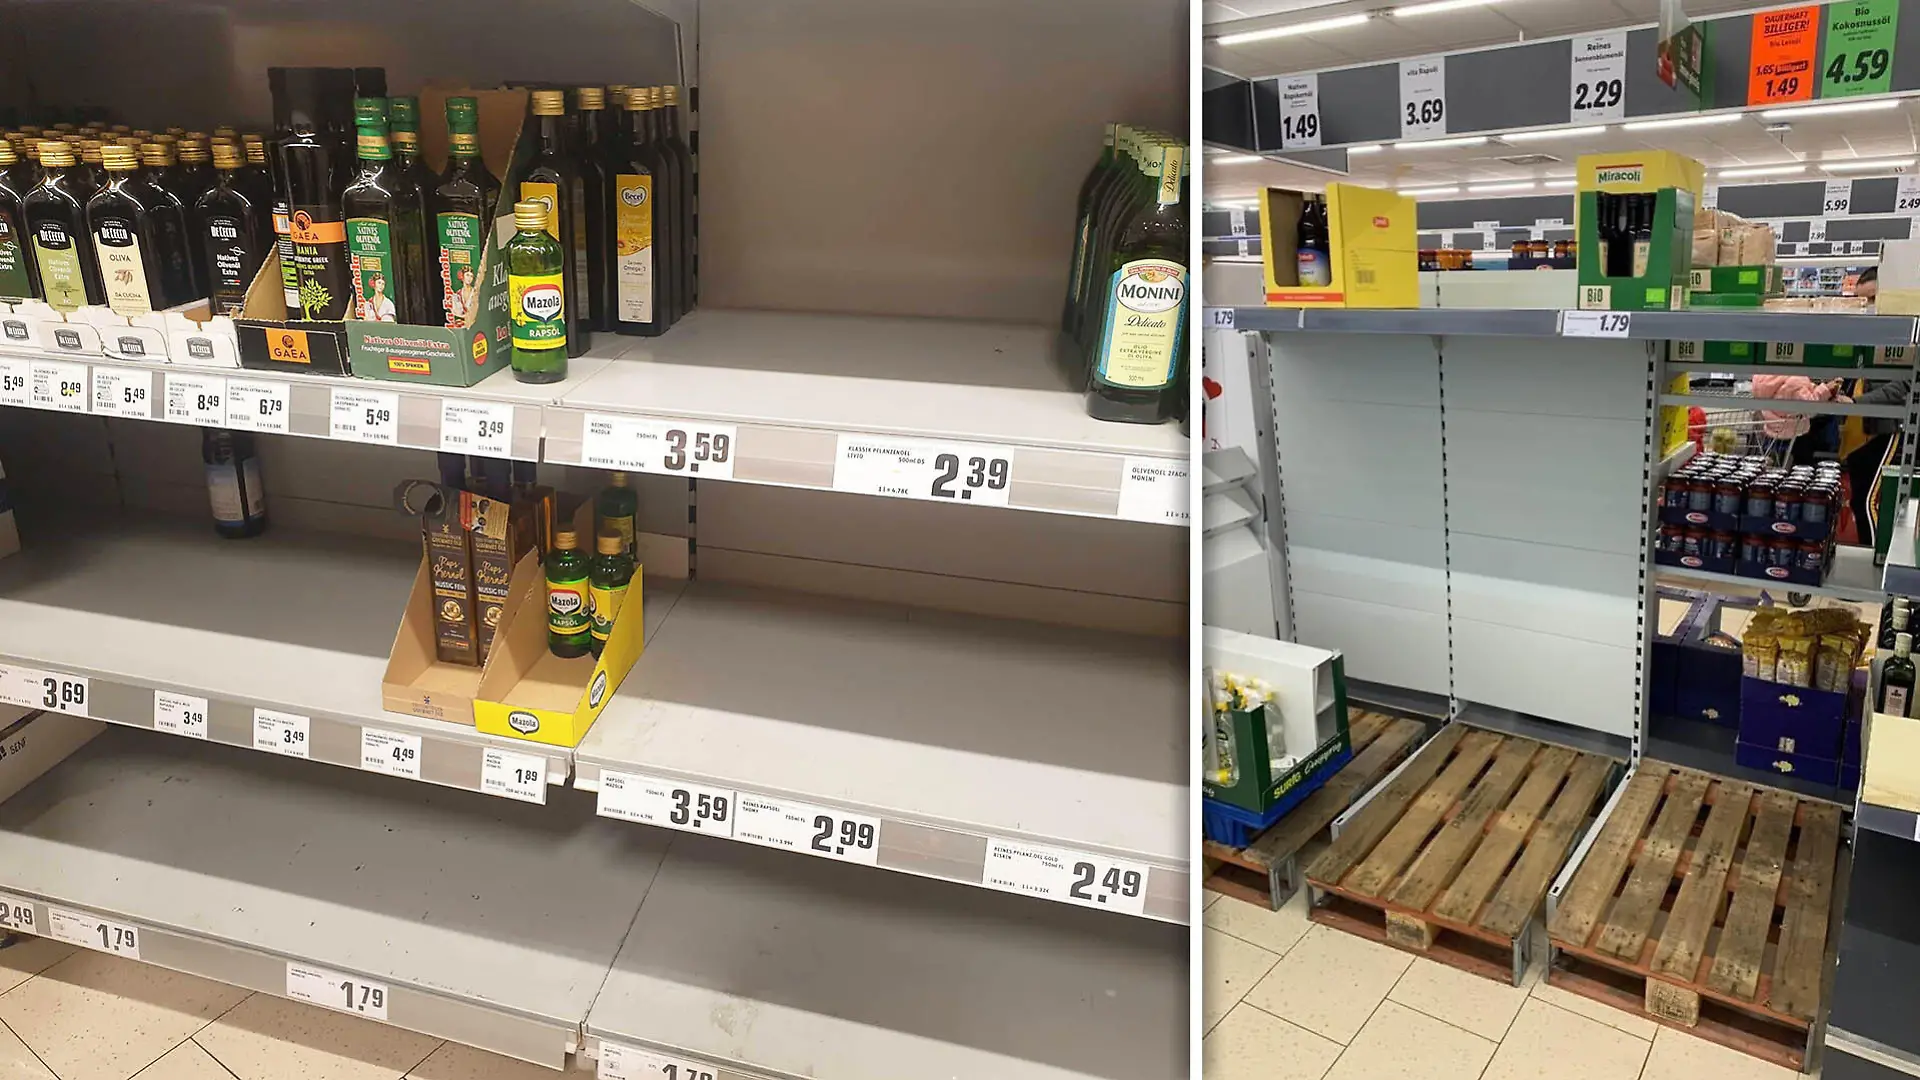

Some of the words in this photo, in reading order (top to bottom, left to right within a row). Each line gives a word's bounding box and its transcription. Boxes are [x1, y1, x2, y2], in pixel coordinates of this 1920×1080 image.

[1764, 11, 1808, 24] DAUERHAFT
[1856, 6, 1870, 16] Bio
[1764, 20, 1810, 34] BILLIGER!
[1832, 16, 1890, 31] Kokosnussöl
[1826, 49, 1888, 84] 4.59
[1574, 79, 1622, 110] 2.29
[1766, 77, 1798, 97] 1.49
[1406, 98, 1443, 126] 3.69
[1284, 114, 1317, 140] 1.49
[1164, 160, 1178, 192] Delicato
[1598, 171, 1641, 184] Miracoli
[625, 192, 643, 200] Becel
[1899, 198, 1920, 209] 2.49
[1825, 200, 1848, 212] 5.99
[292, 231, 319, 241] GAEA
[109, 254, 132, 262] OLIVA
[222, 268, 238, 276] Extra
[439, 246, 454, 310] Española
[351, 253, 366, 320] Española
[1121, 284, 1180, 300] MONINI
[527, 296, 560, 309] Mazola
[1124, 314, 1167, 328] Delicato
[1214, 311, 1232, 325] 1.79
[1600, 314, 1628, 332] 1.79
[530, 328, 560, 338] RAPSÖL
[274, 348, 306, 360] GAEA
[4, 376, 24, 392] 5.49
[61, 381, 81, 398] 8.49
[124, 387, 145, 404] 5.49
[198, 394, 219, 410] 8.49
[260, 398, 282, 416] 6.79
[366, 408, 390, 426] 5.49
[478, 420, 504, 438] 3.49
[664, 429, 730, 472] 3.59
[872, 447, 910, 456] PFLANZENOEL
[931, 453, 1008, 500] 2.39
[1132, 467, 1166, 476] OLIVENOEL
[552, 596, 578, 606] Mazola
[42, 678, 84, 710] 3.69
[183, 711, 203, 726] 3.49
[512, 716, 536, 728] Mazola
[284, 729, 304, 744] 3.49
[392, 747, 414, 762] 4.49
[516, 768, 538, 784] 1.89
[1274, 772, 1302, 799] SURIG
[670, 789, 728, 828] 3.59
[811, 815, 874, 856] 2.99
[1070, 861, 1142, 903] 2.49
[0, 902, 33, 928] 2.49
[96, 924, 135, 951] 1.79
[340, 982, 384, 1012] 1.79
